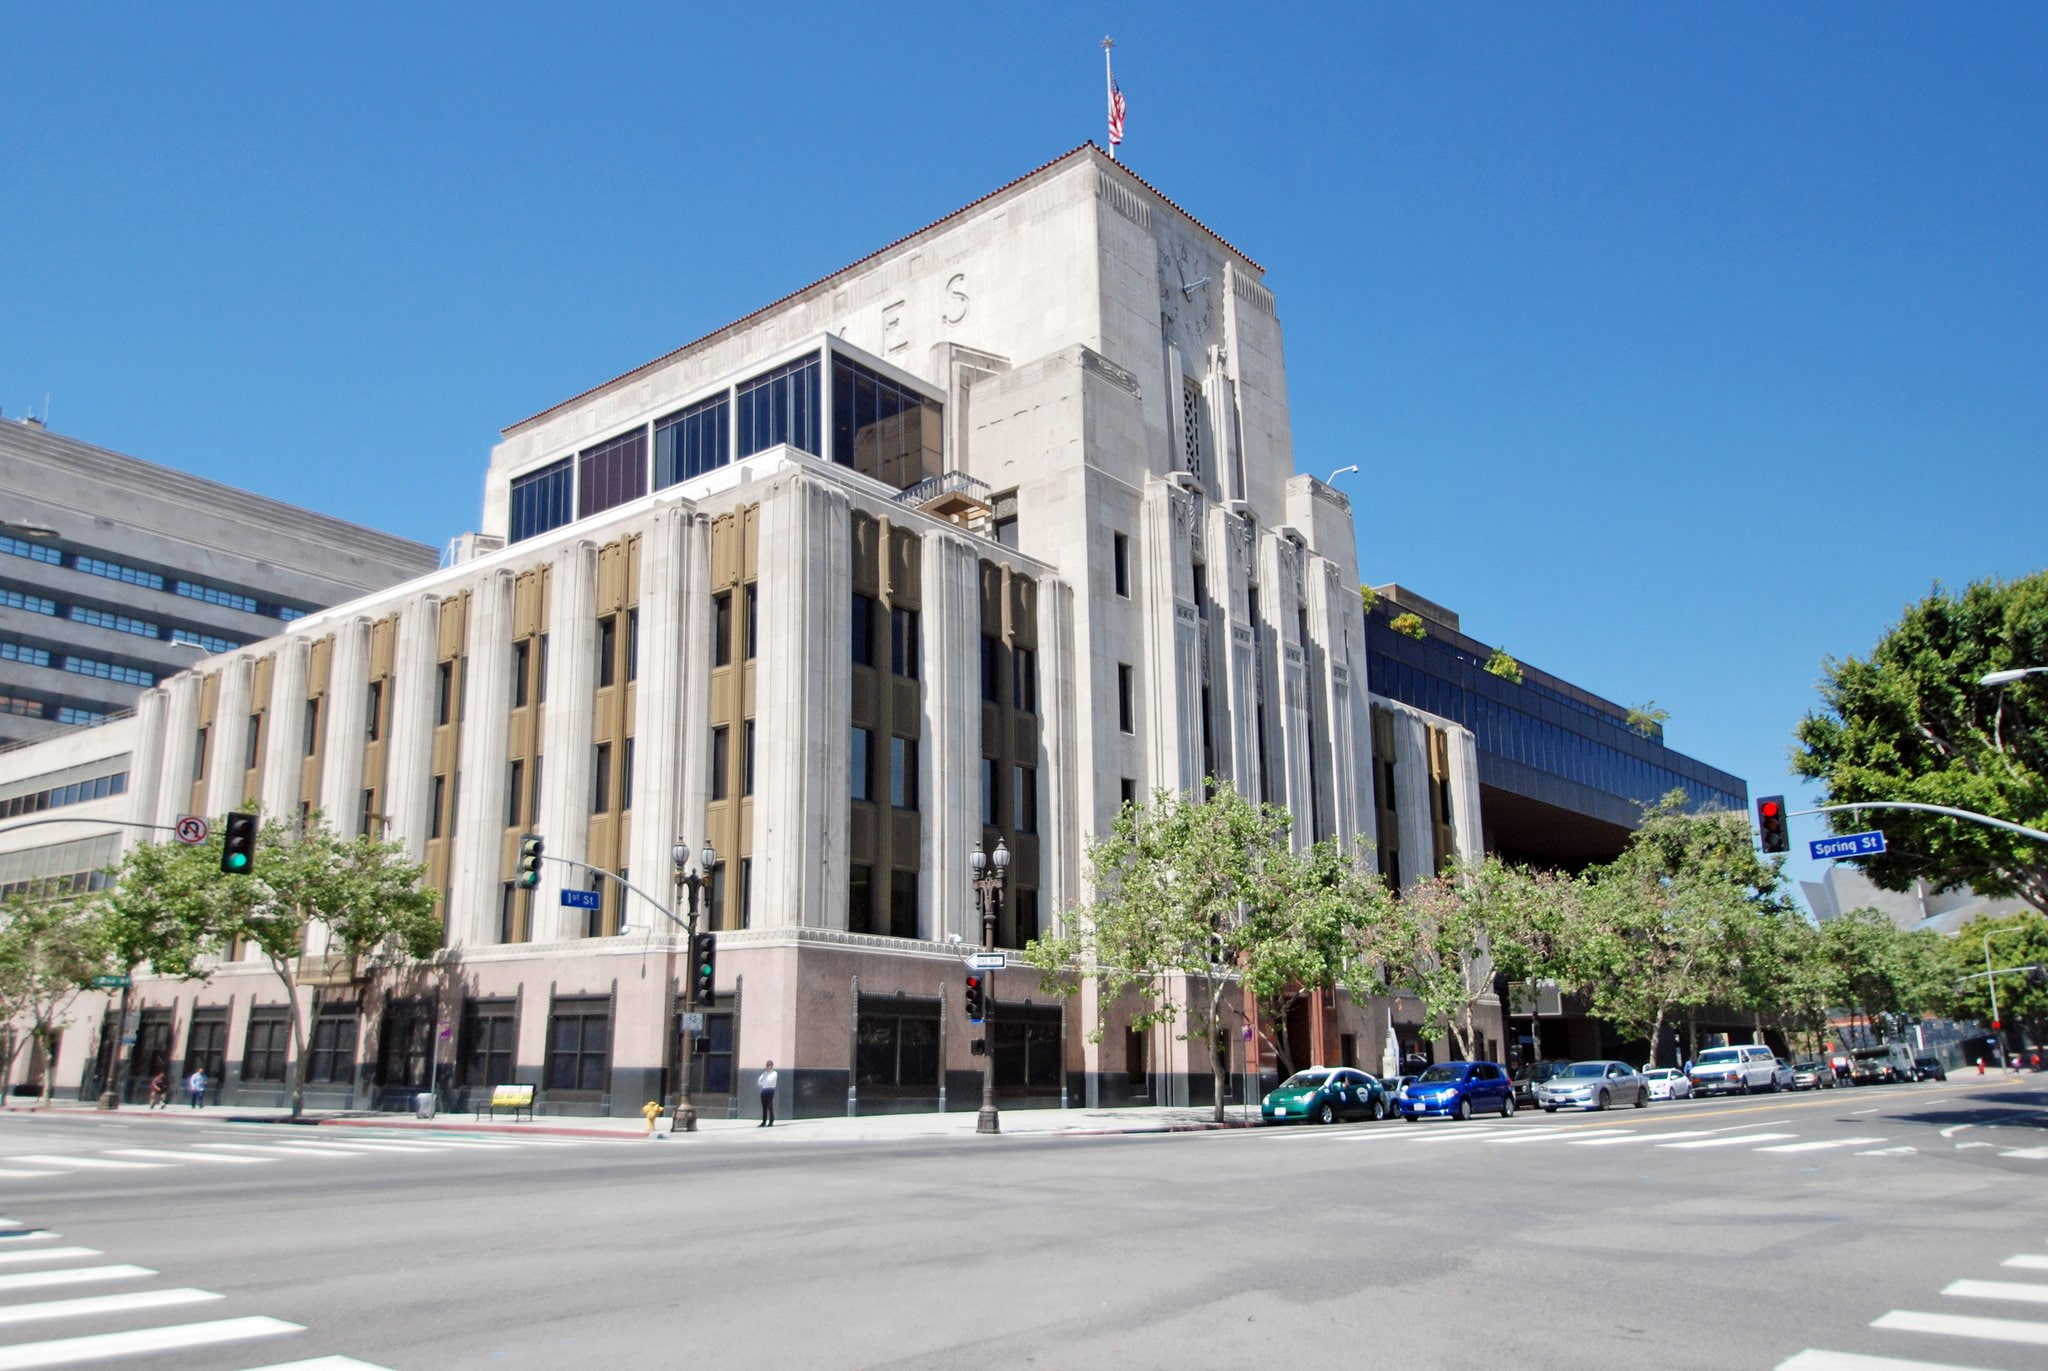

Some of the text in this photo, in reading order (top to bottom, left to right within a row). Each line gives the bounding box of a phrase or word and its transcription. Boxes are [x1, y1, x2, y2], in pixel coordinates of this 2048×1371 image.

[838, 273, 970, 358] ES
[1815, 836, 1877, 856] Spring St
[567, 892, 594, 906] 1st St
